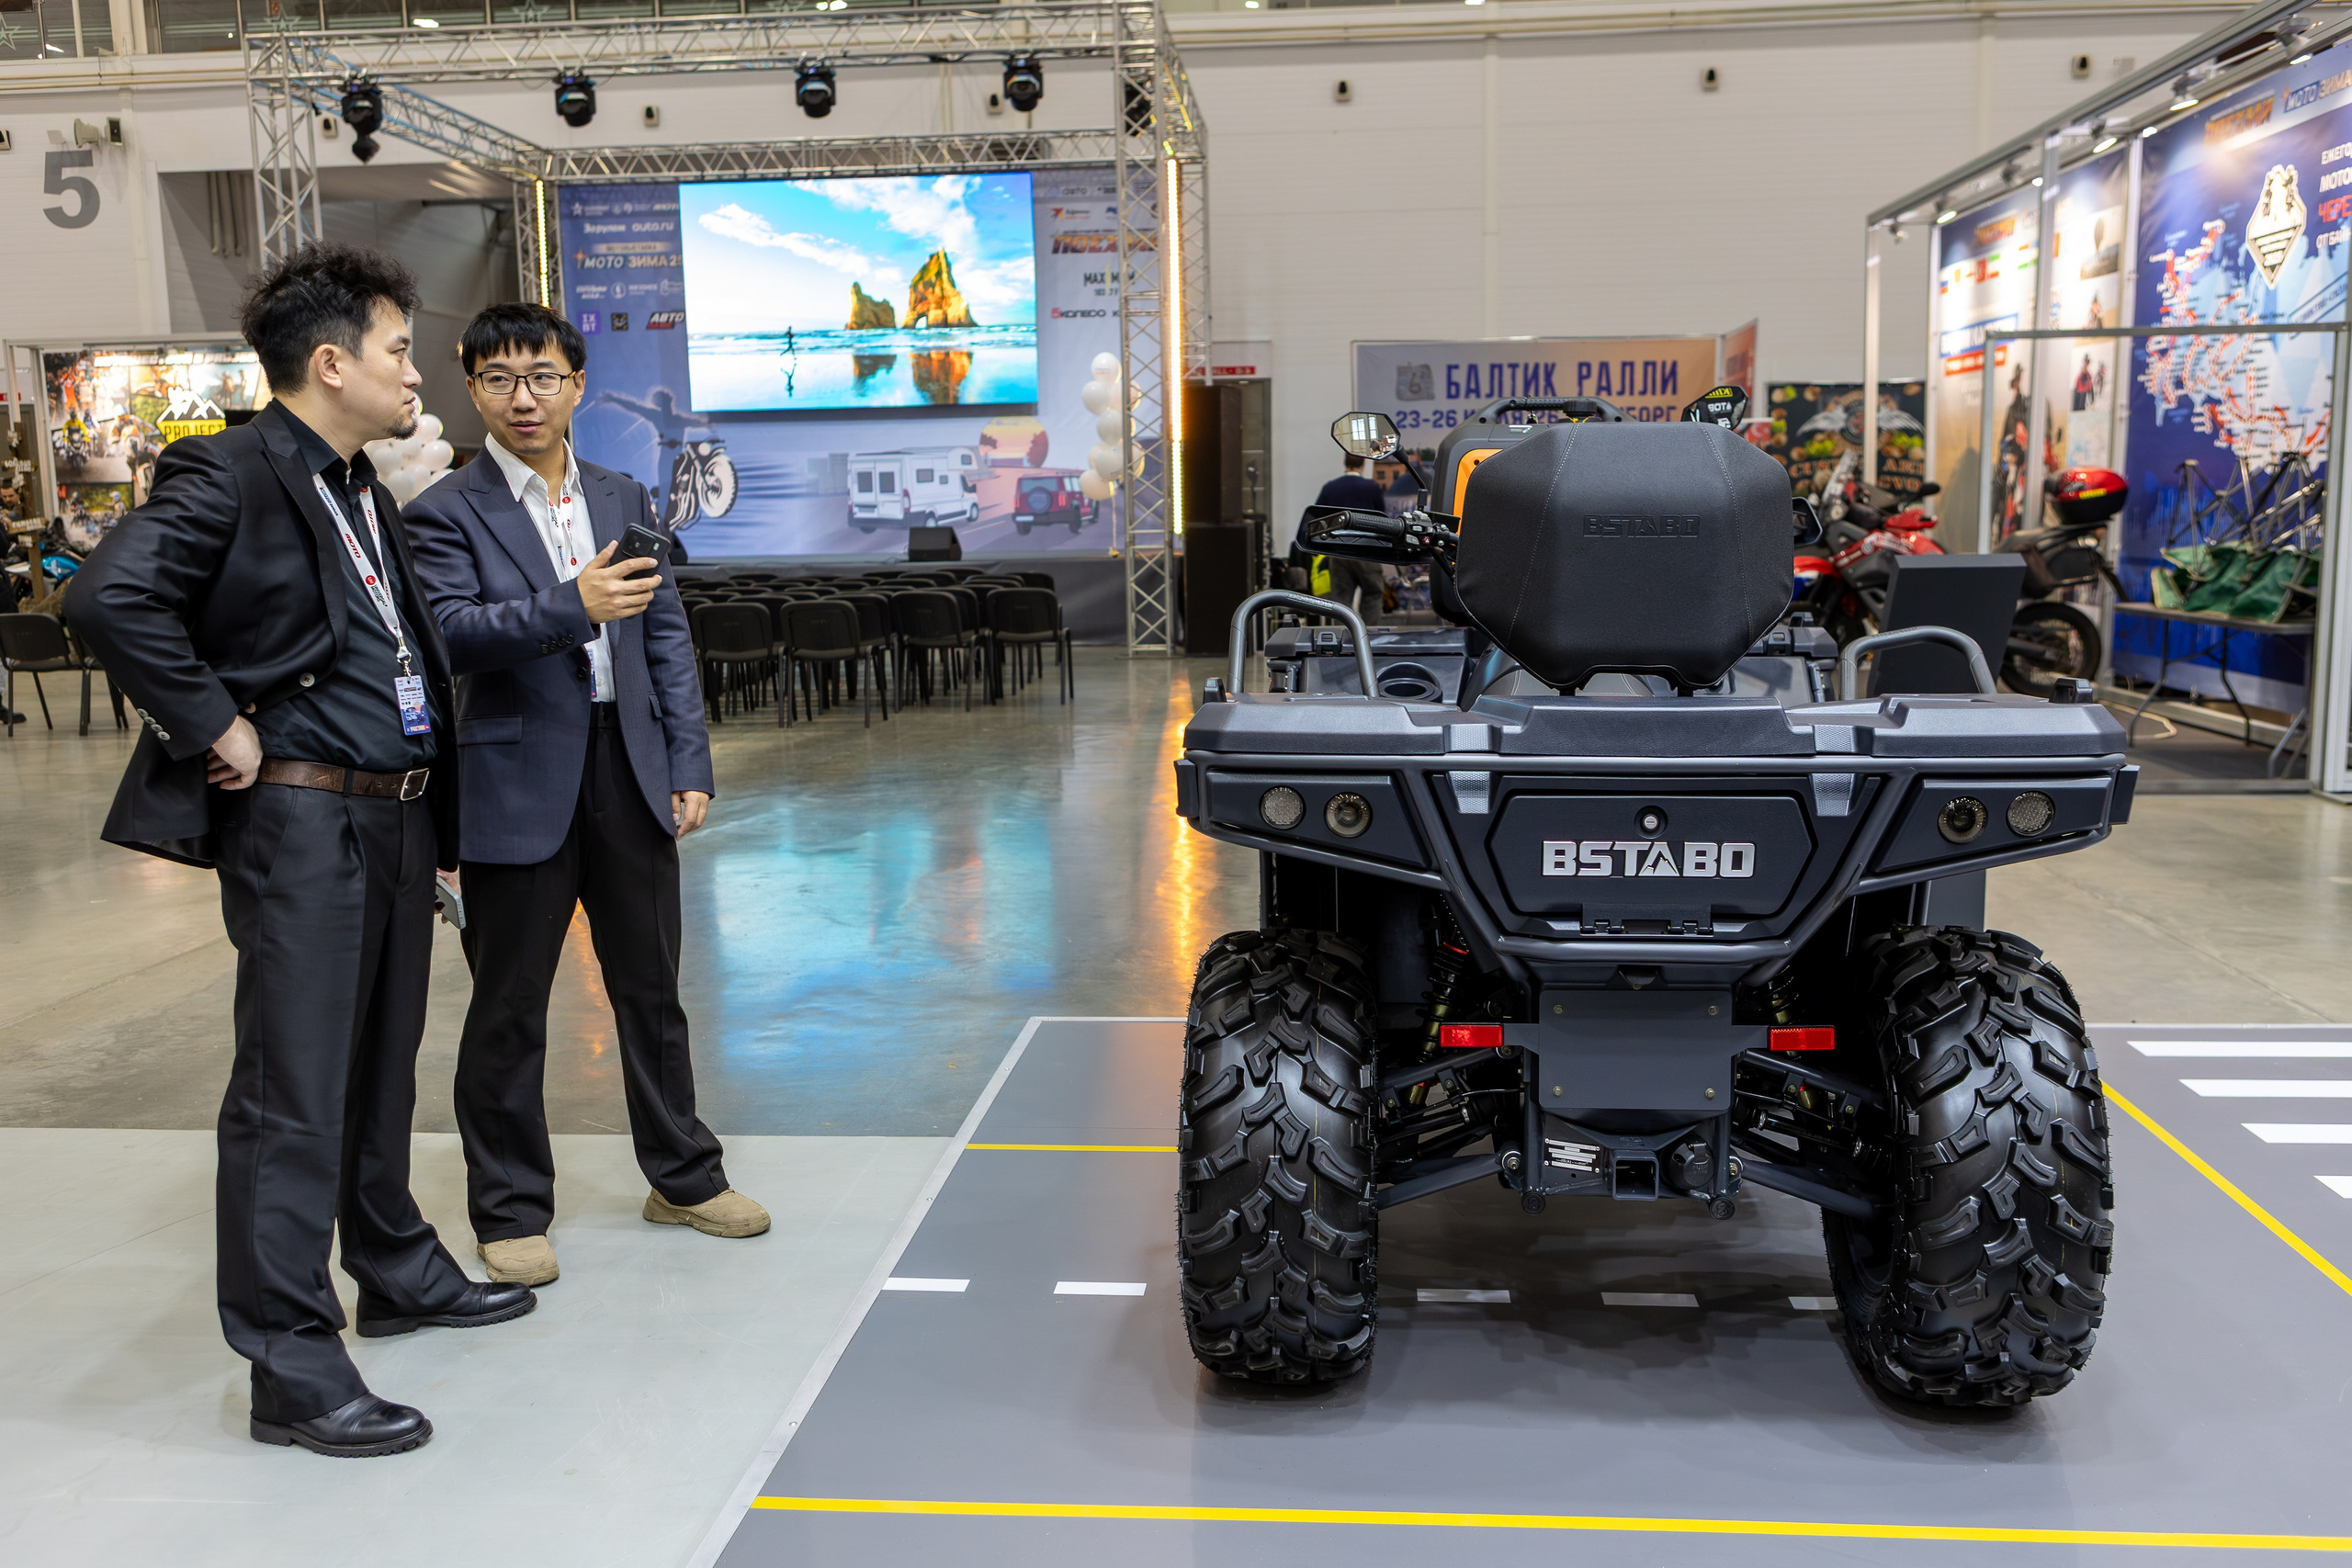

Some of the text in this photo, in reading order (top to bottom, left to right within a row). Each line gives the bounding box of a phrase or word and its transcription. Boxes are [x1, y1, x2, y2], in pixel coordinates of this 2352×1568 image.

[43, 150, 101, 229] 5
[2319, 166, 2352, 193] МОТО
[2318, 195, 2352, 223] ЧЕРЕ
[584, 256, 625, 269] МОТО
[628, 254, 668, 268] ЗИМА
[1445, 362, 1557, 399] БАЛТИК
[1577, 360, 1678, 397] РАЛЛИ
[1396, 410, 1457, 429] 23-26
[1583, 514, 1700, 538] BSTABO
[1542, 840, 1756, 878] BSTABO
